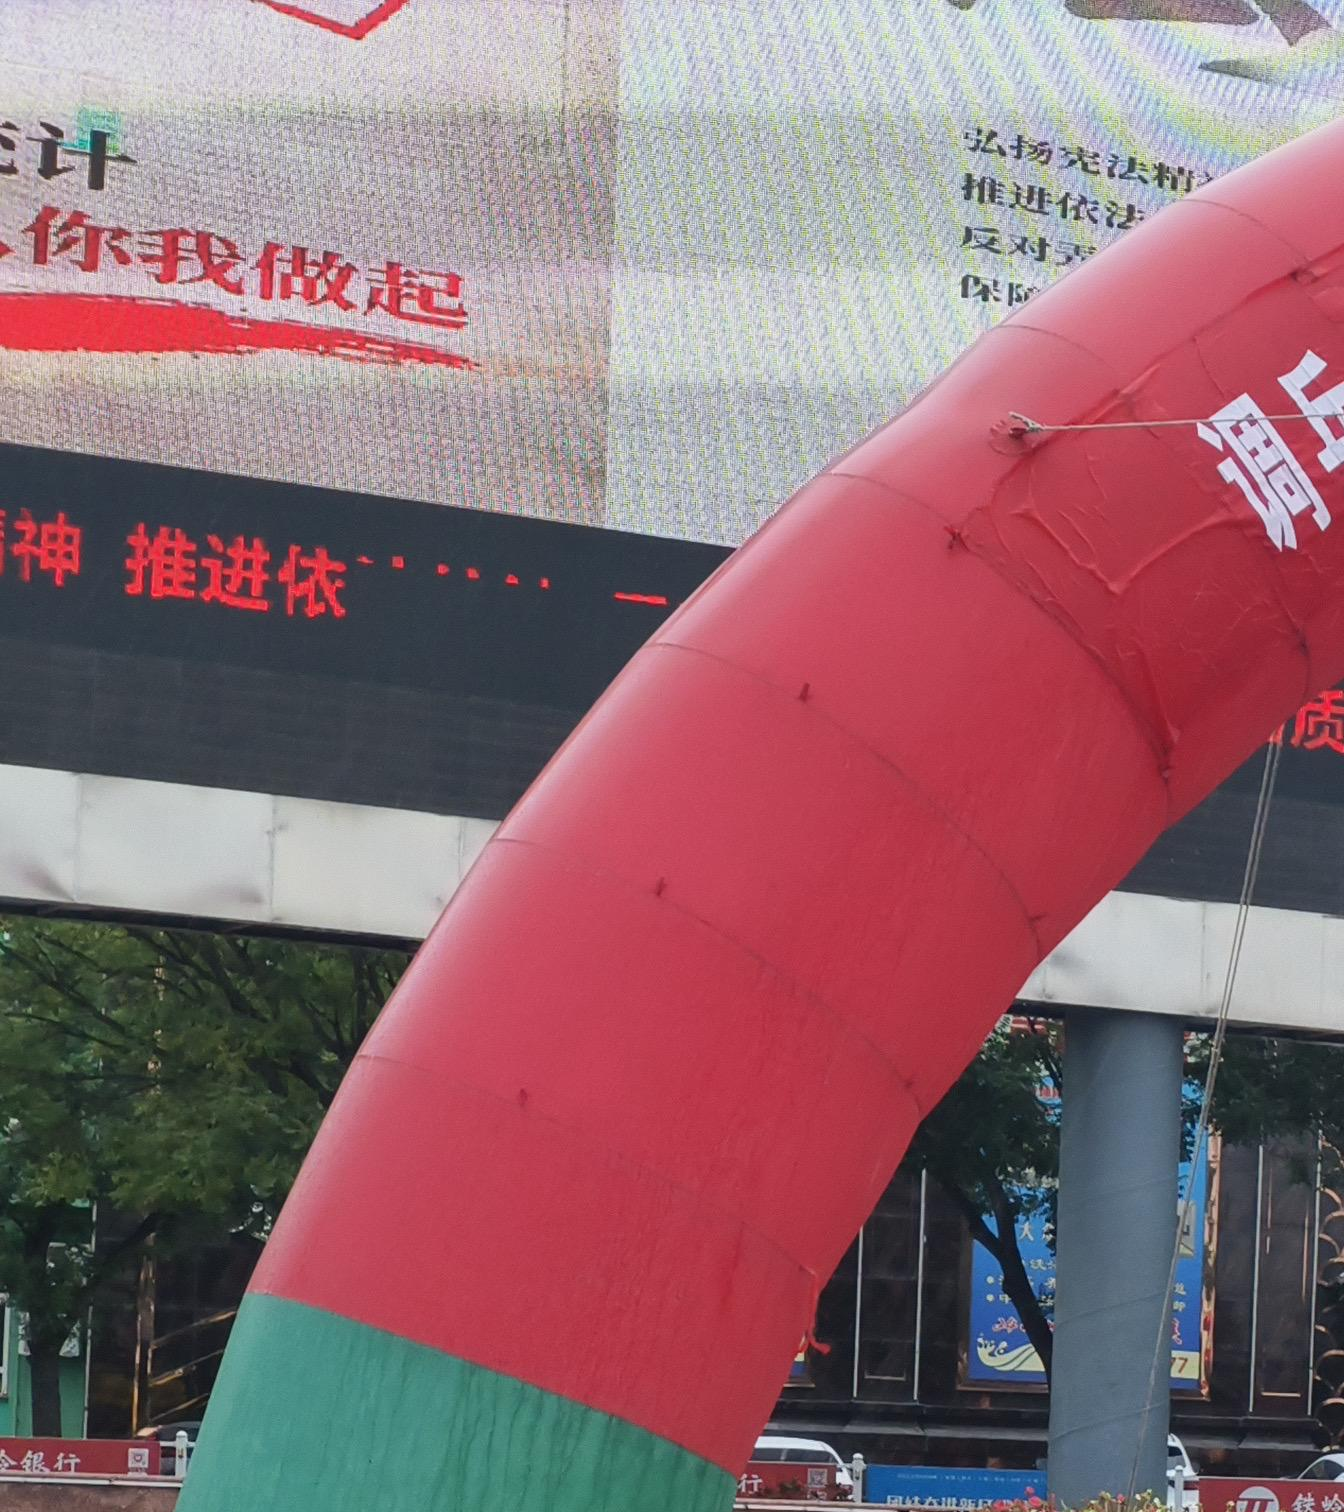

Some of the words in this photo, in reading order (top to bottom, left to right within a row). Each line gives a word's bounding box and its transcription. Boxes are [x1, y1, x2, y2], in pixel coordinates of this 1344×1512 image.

[963, 128, 1213, 193] 弘扬宪法精
[0, 205, 468, 329] 你我做起
[0, 507, 81, 587] 神
